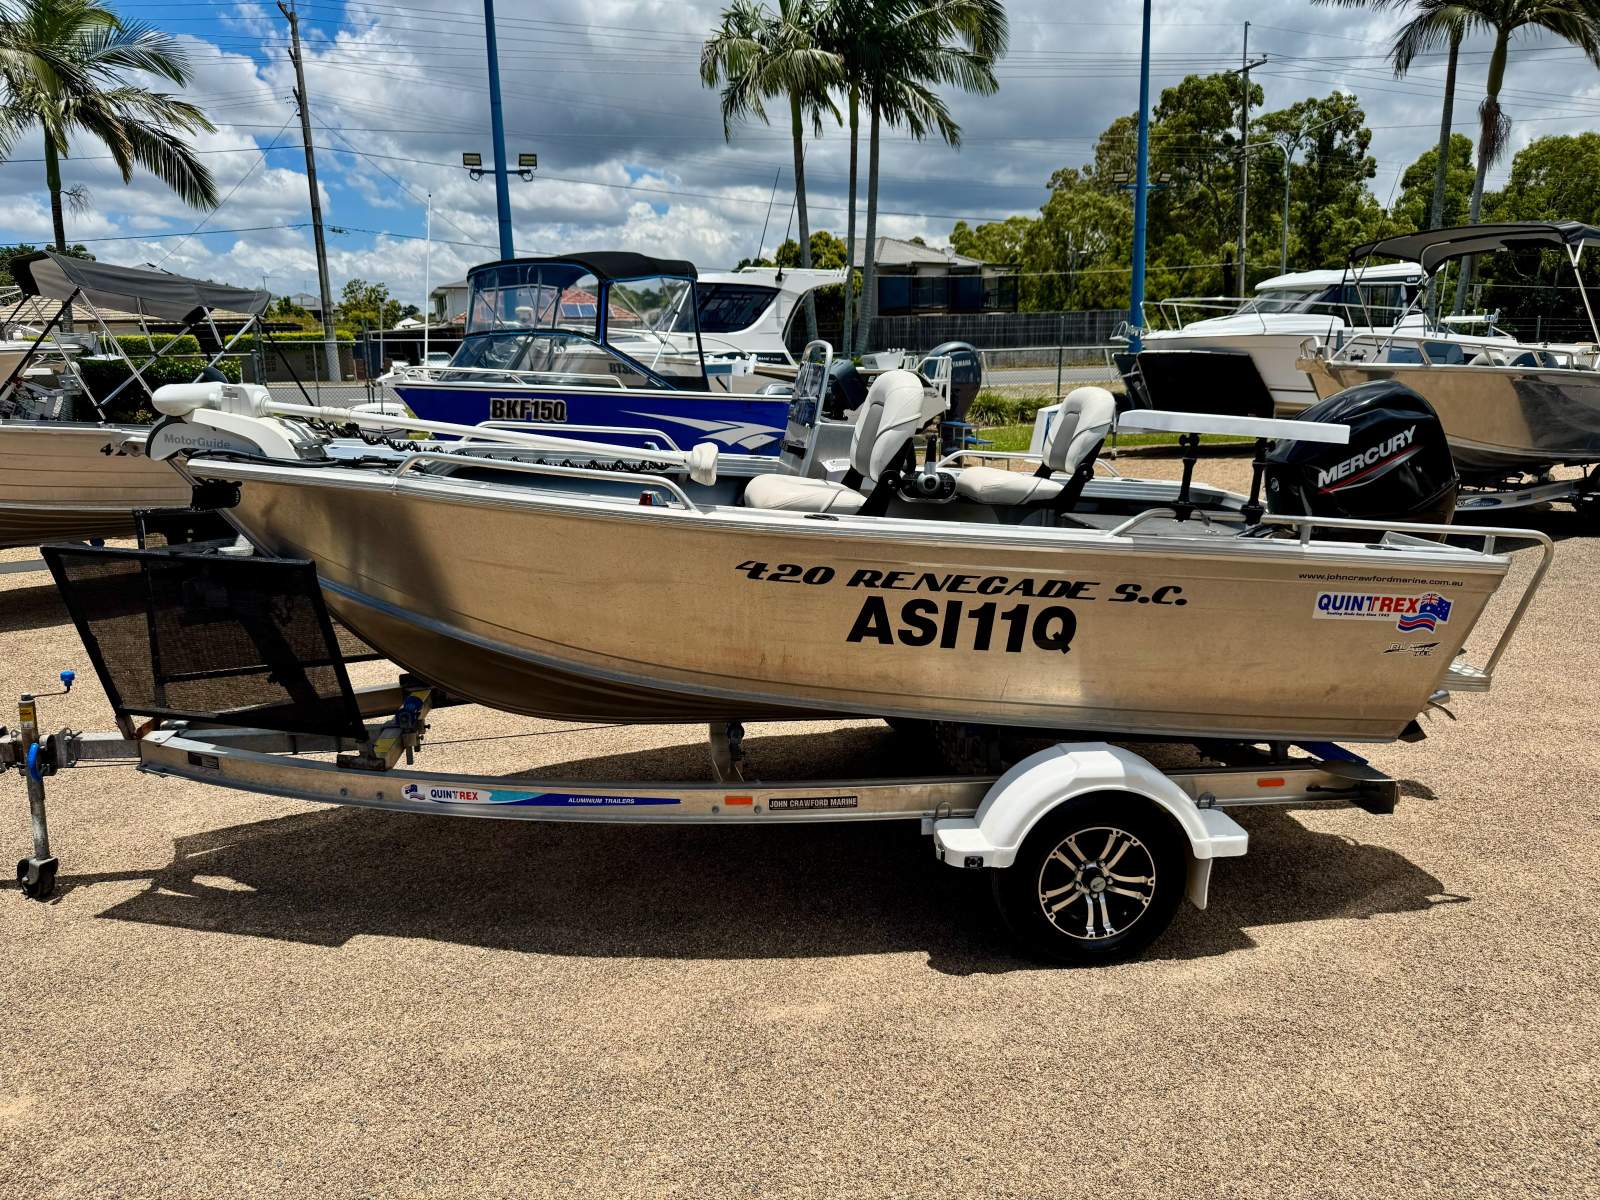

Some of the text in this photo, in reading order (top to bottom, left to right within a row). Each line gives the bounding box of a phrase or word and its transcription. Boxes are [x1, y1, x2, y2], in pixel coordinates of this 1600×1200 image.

[490, 398, 567, 422] BKF15Q
[163, 433, 232, 449] MotorGuide
[1318, 424, 1416, 488] MERCURY
[735, 560, 1188, 606] 420 RENEGADE S.C.
[1298, 573, 1464, 587] www.johncrawfordmarine.com.au
[1318, 593, 1420, 613] QUINTREX
[845, 595, 1077, 654] ASI11Q
[430, 789, 479, 801] QUINTREX
[769, 797, 857, 808] JOHN CRAWFORD MARINE
